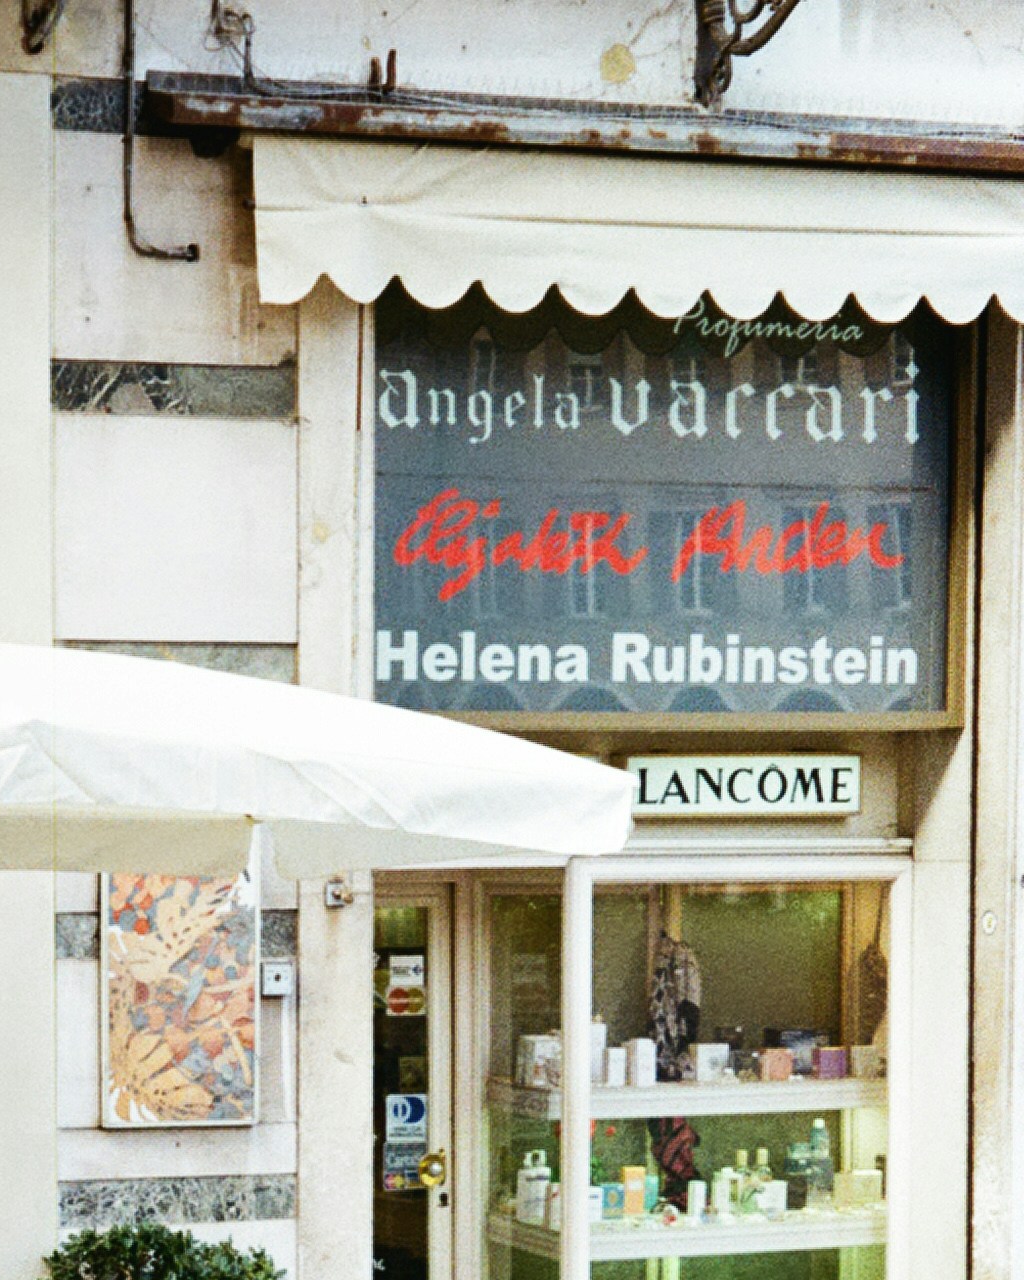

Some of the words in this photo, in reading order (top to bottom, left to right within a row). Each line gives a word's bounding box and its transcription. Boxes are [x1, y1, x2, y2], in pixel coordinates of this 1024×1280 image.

[671, 499, 905, 583] Arden
[375, 630, 590, 683] Helena
[612, 632, 919, 686] Rubinstein
[637, 763, 853, 804] LANCÔME
